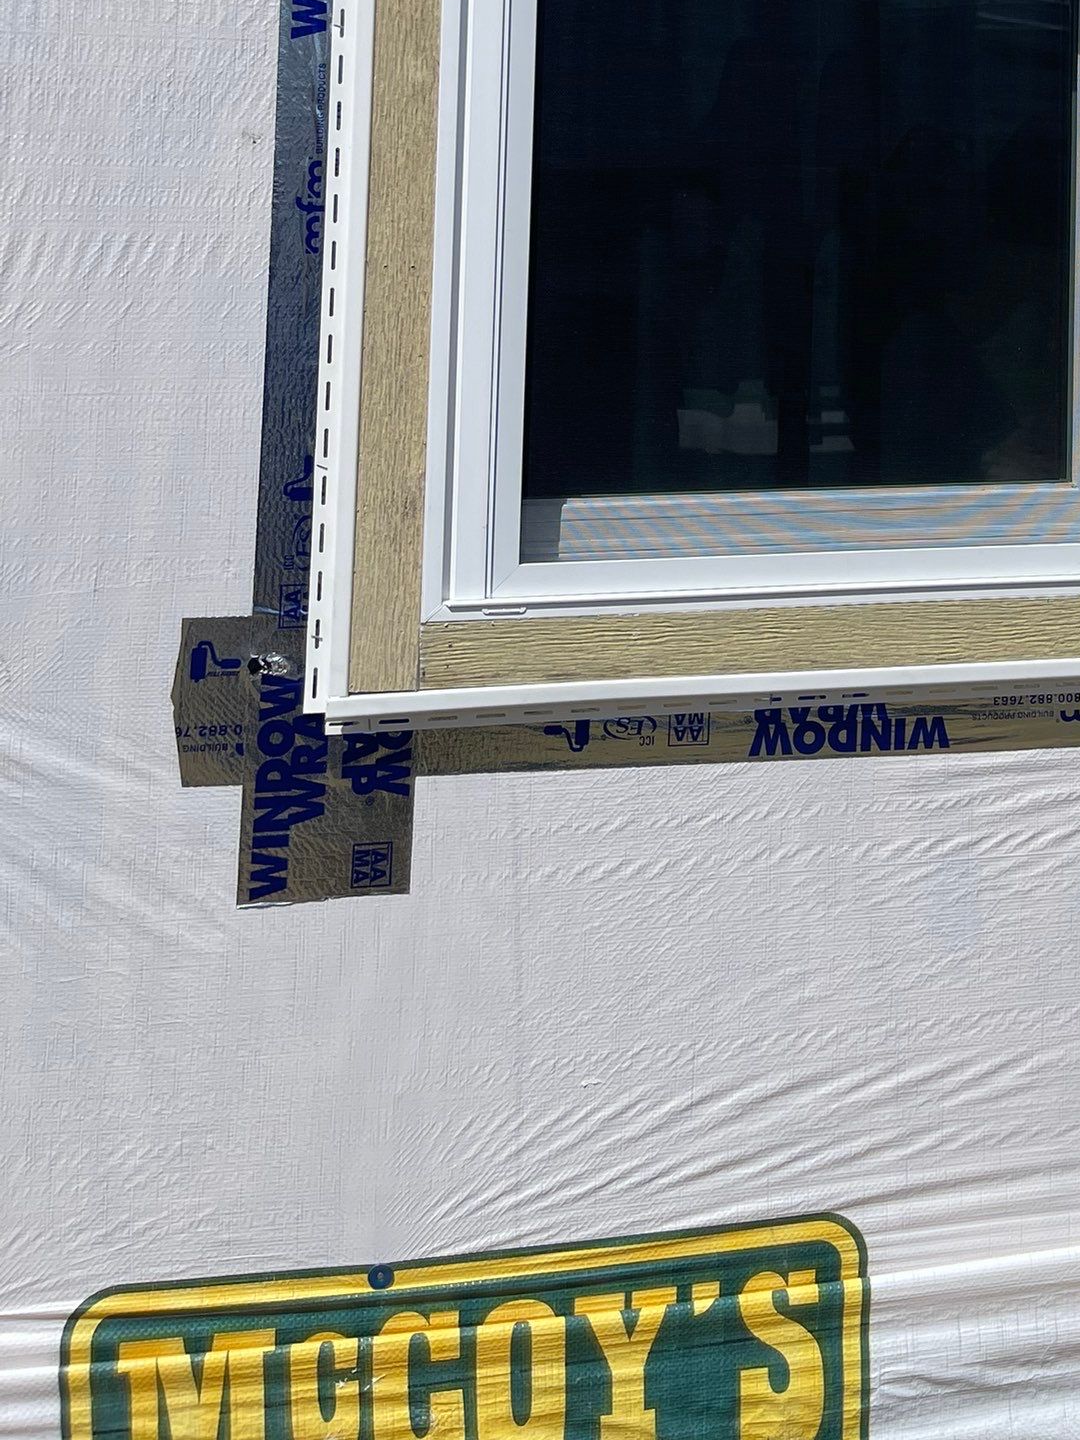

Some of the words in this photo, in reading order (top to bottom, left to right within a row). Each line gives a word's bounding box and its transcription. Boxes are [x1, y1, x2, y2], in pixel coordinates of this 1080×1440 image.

[317, 63, 327, 111] PRODUCTS
[316, 113, 325, 154] BUILDING
[993, 693, 1080, 705] 800.882.7663
[1017, 710, 1054, 719] BUILDING
[182, 743, 228, 752] BUILDING
[748, 716, 952, 757] WINDOW
[249, 674, 299, 900] WINDOW
